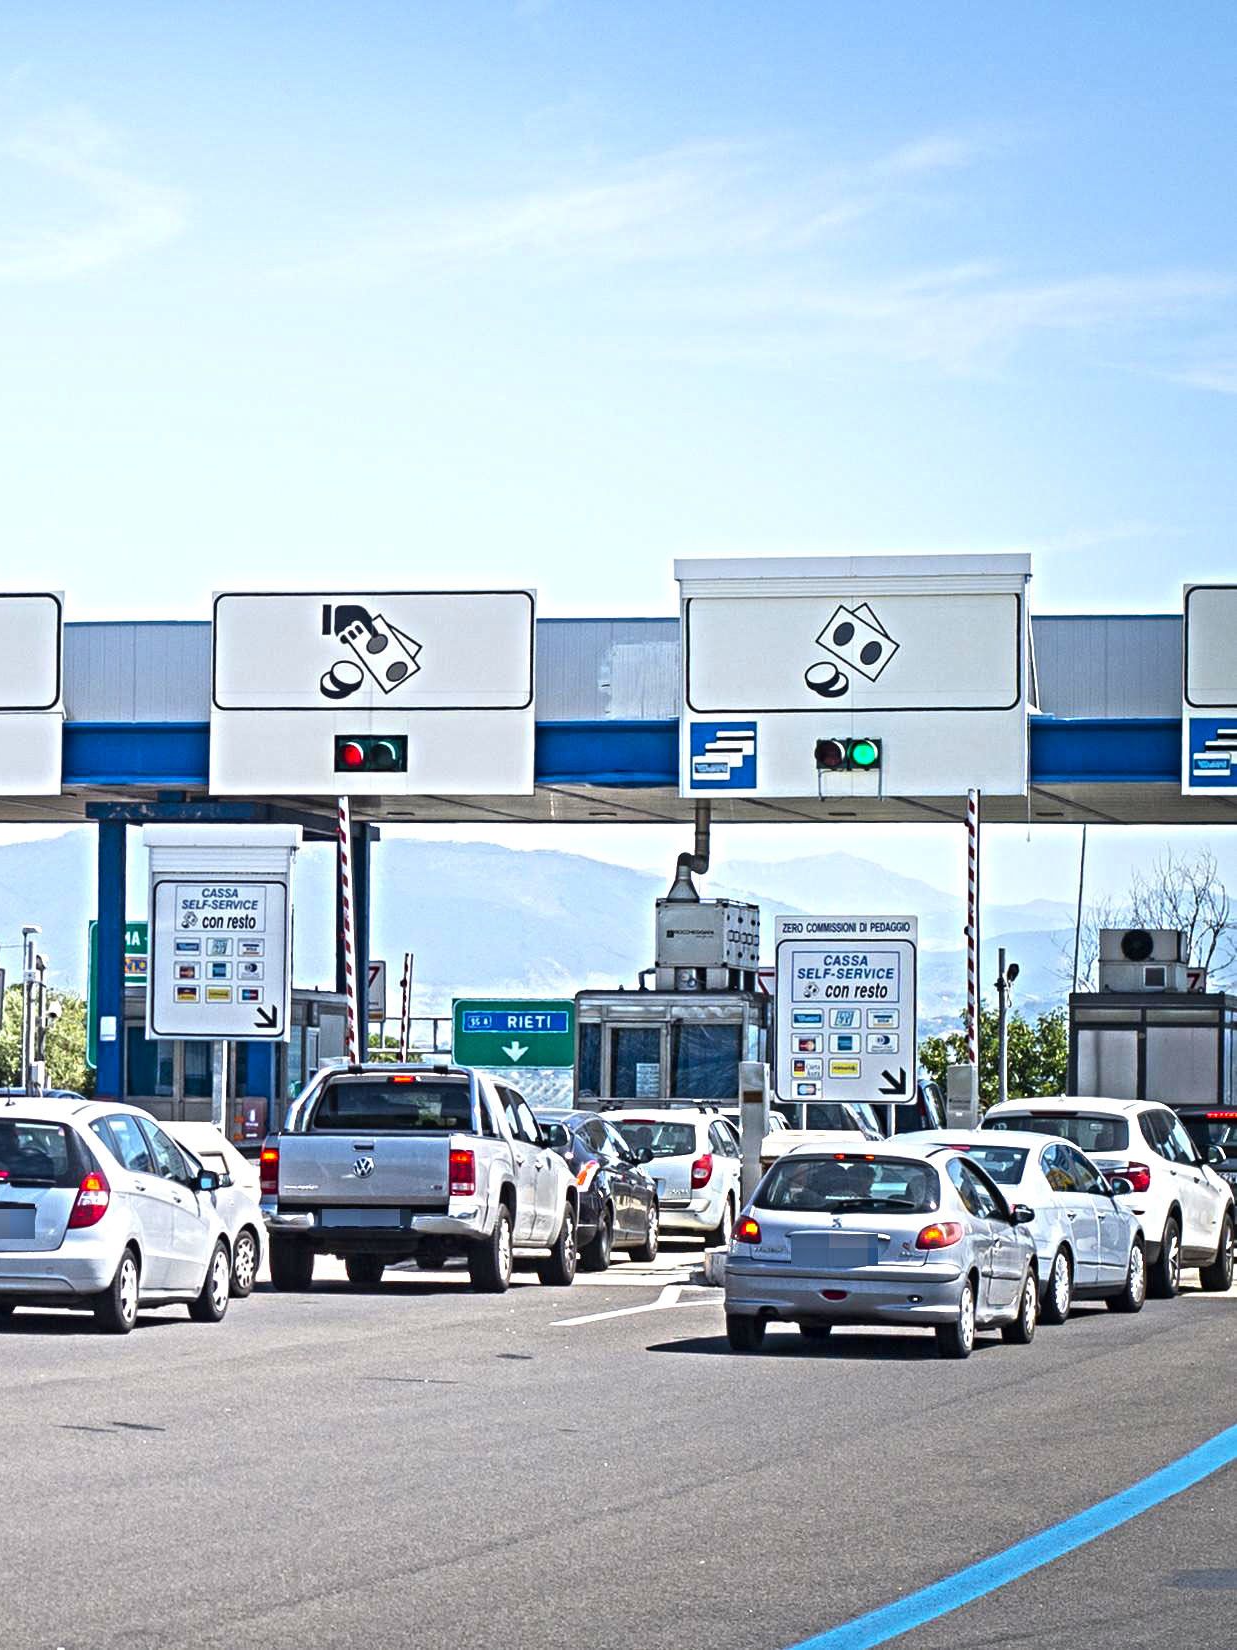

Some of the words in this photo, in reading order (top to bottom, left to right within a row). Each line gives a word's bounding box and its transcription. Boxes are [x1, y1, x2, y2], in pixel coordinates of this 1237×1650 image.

[201, 887, 239, 898] CASSA
[181, 899, 259, 911] SELF-SERVICE
[202, 916, 224, 929] con
[227, 914, 257, 930] resto
[782, 922, 804, 934] ZERO
[806, 922, 857, 933] COMMISSIONI
[859, 922, 868, 933] DI
[870, 921, 911, 933] PEDAGGIO
[823, 954, 869, 967] CASSA
[797, 967, 895, 980] SELF-SERVICE
[825, 984, 849, 999] con
[854, 982, 888, 999] resto
[507, 1015, 551, 1029] RIETI
